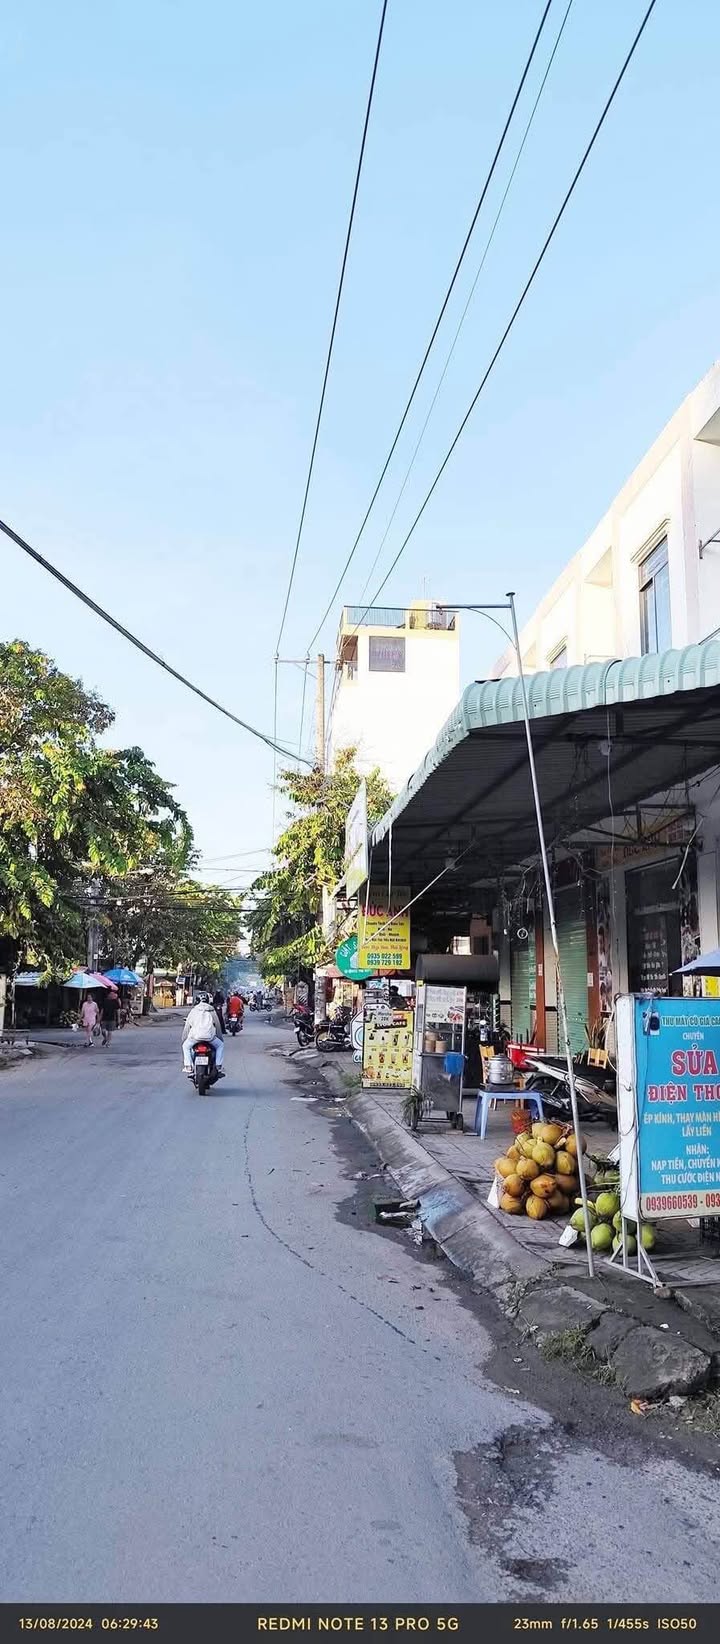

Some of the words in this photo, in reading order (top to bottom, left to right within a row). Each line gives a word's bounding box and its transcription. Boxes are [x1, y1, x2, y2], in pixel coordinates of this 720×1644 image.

[662, 1016, 675, 1026] THU
[675, 1014, 688, 1026] MÁY
[671, 1043, 718, 1076] SỬA
[647, 1081, 688, 1104] ĐIỆN
[643, 1111, 653, 1125] ÉP
[654, 1111, 675, 1125] KÍNH,
[676, 1112, 694, 1124] THAY
[695, 1111, 713, 1123] MÀN
[682, 1125, 695, 1137] LẤY
[686, 1142, 709, 1158] NHẬN:
[651, 1159, 667, 1174] NẠP
[661, 1174, 676, 1185] THU
[677, 1171, 697, 1184] CƯỚC
[697, 1171, 715, 1185] ĐIỆN
[646, 1194, 698, 1211] 0939660539
